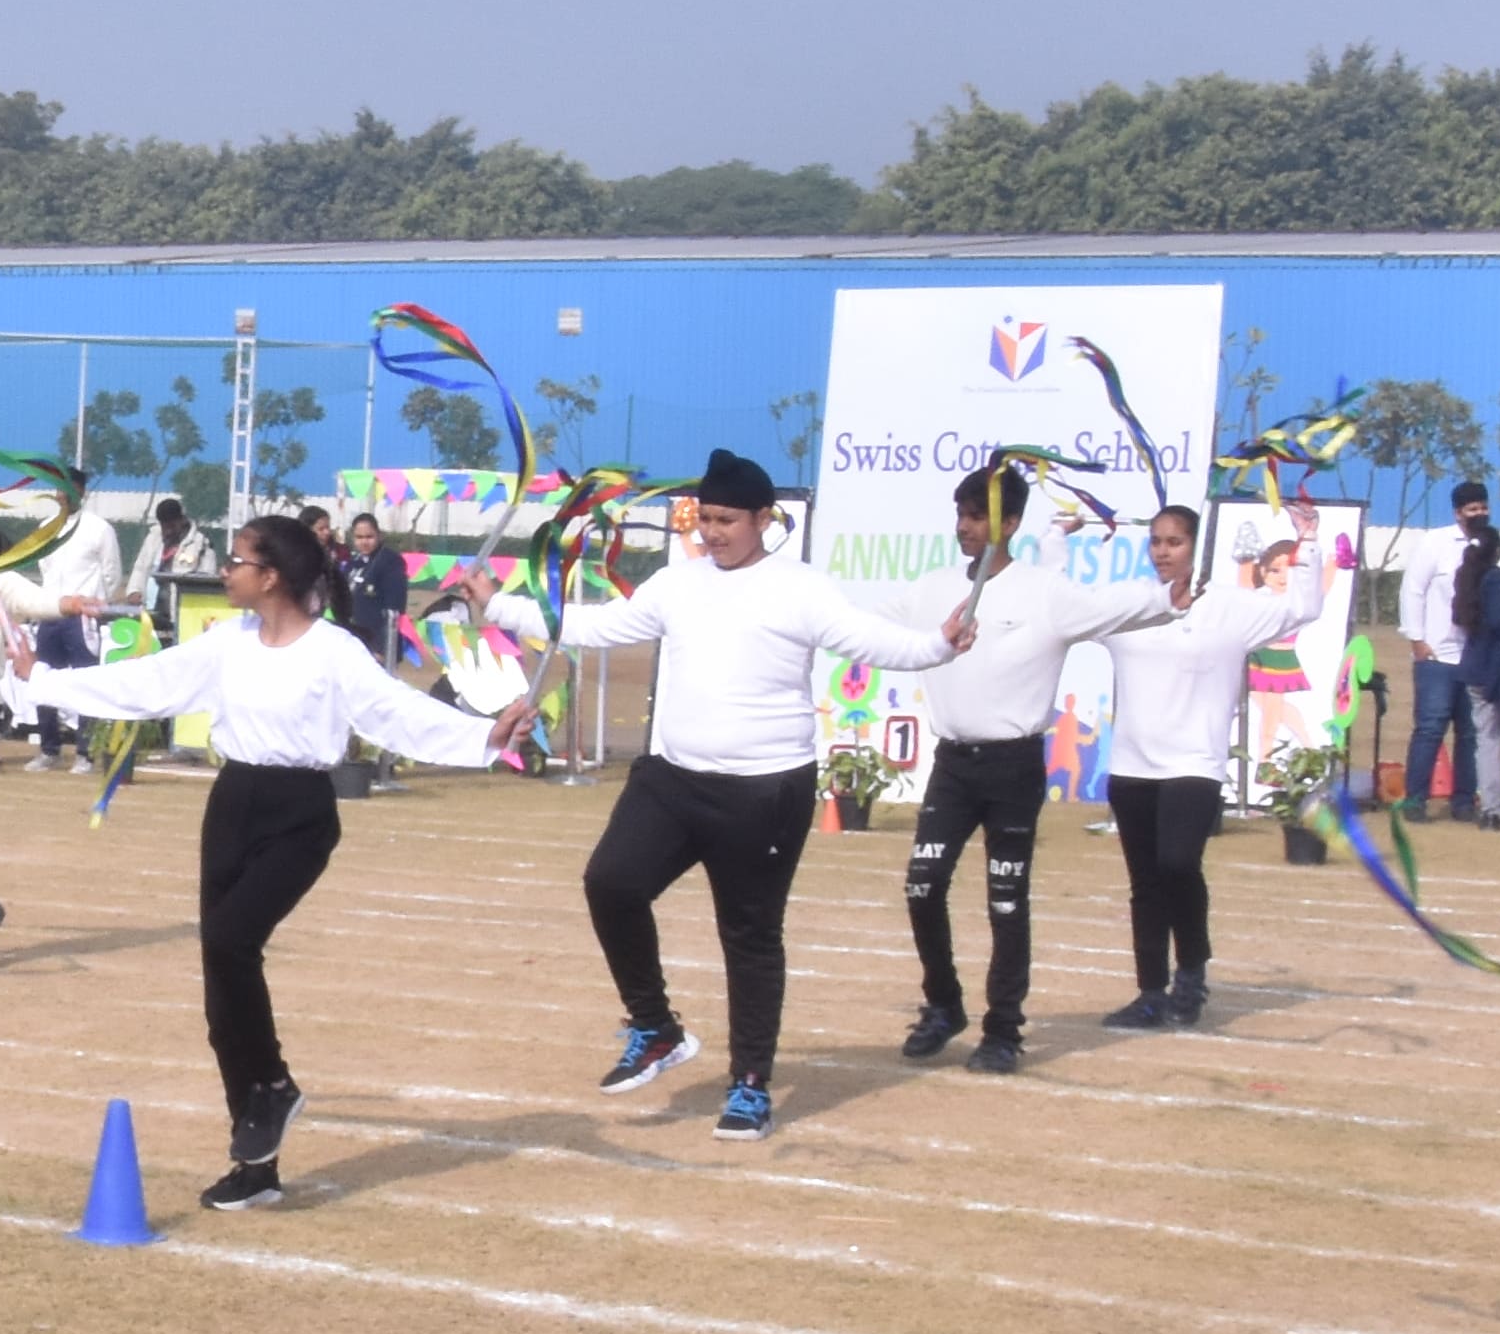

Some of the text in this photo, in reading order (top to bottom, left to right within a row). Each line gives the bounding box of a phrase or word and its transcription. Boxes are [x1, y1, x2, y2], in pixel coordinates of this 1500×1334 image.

[833, 431, 922, 473] Swiss
[894, 722, 910, 761] 1
[989, 858, 1025, 877] BOY
